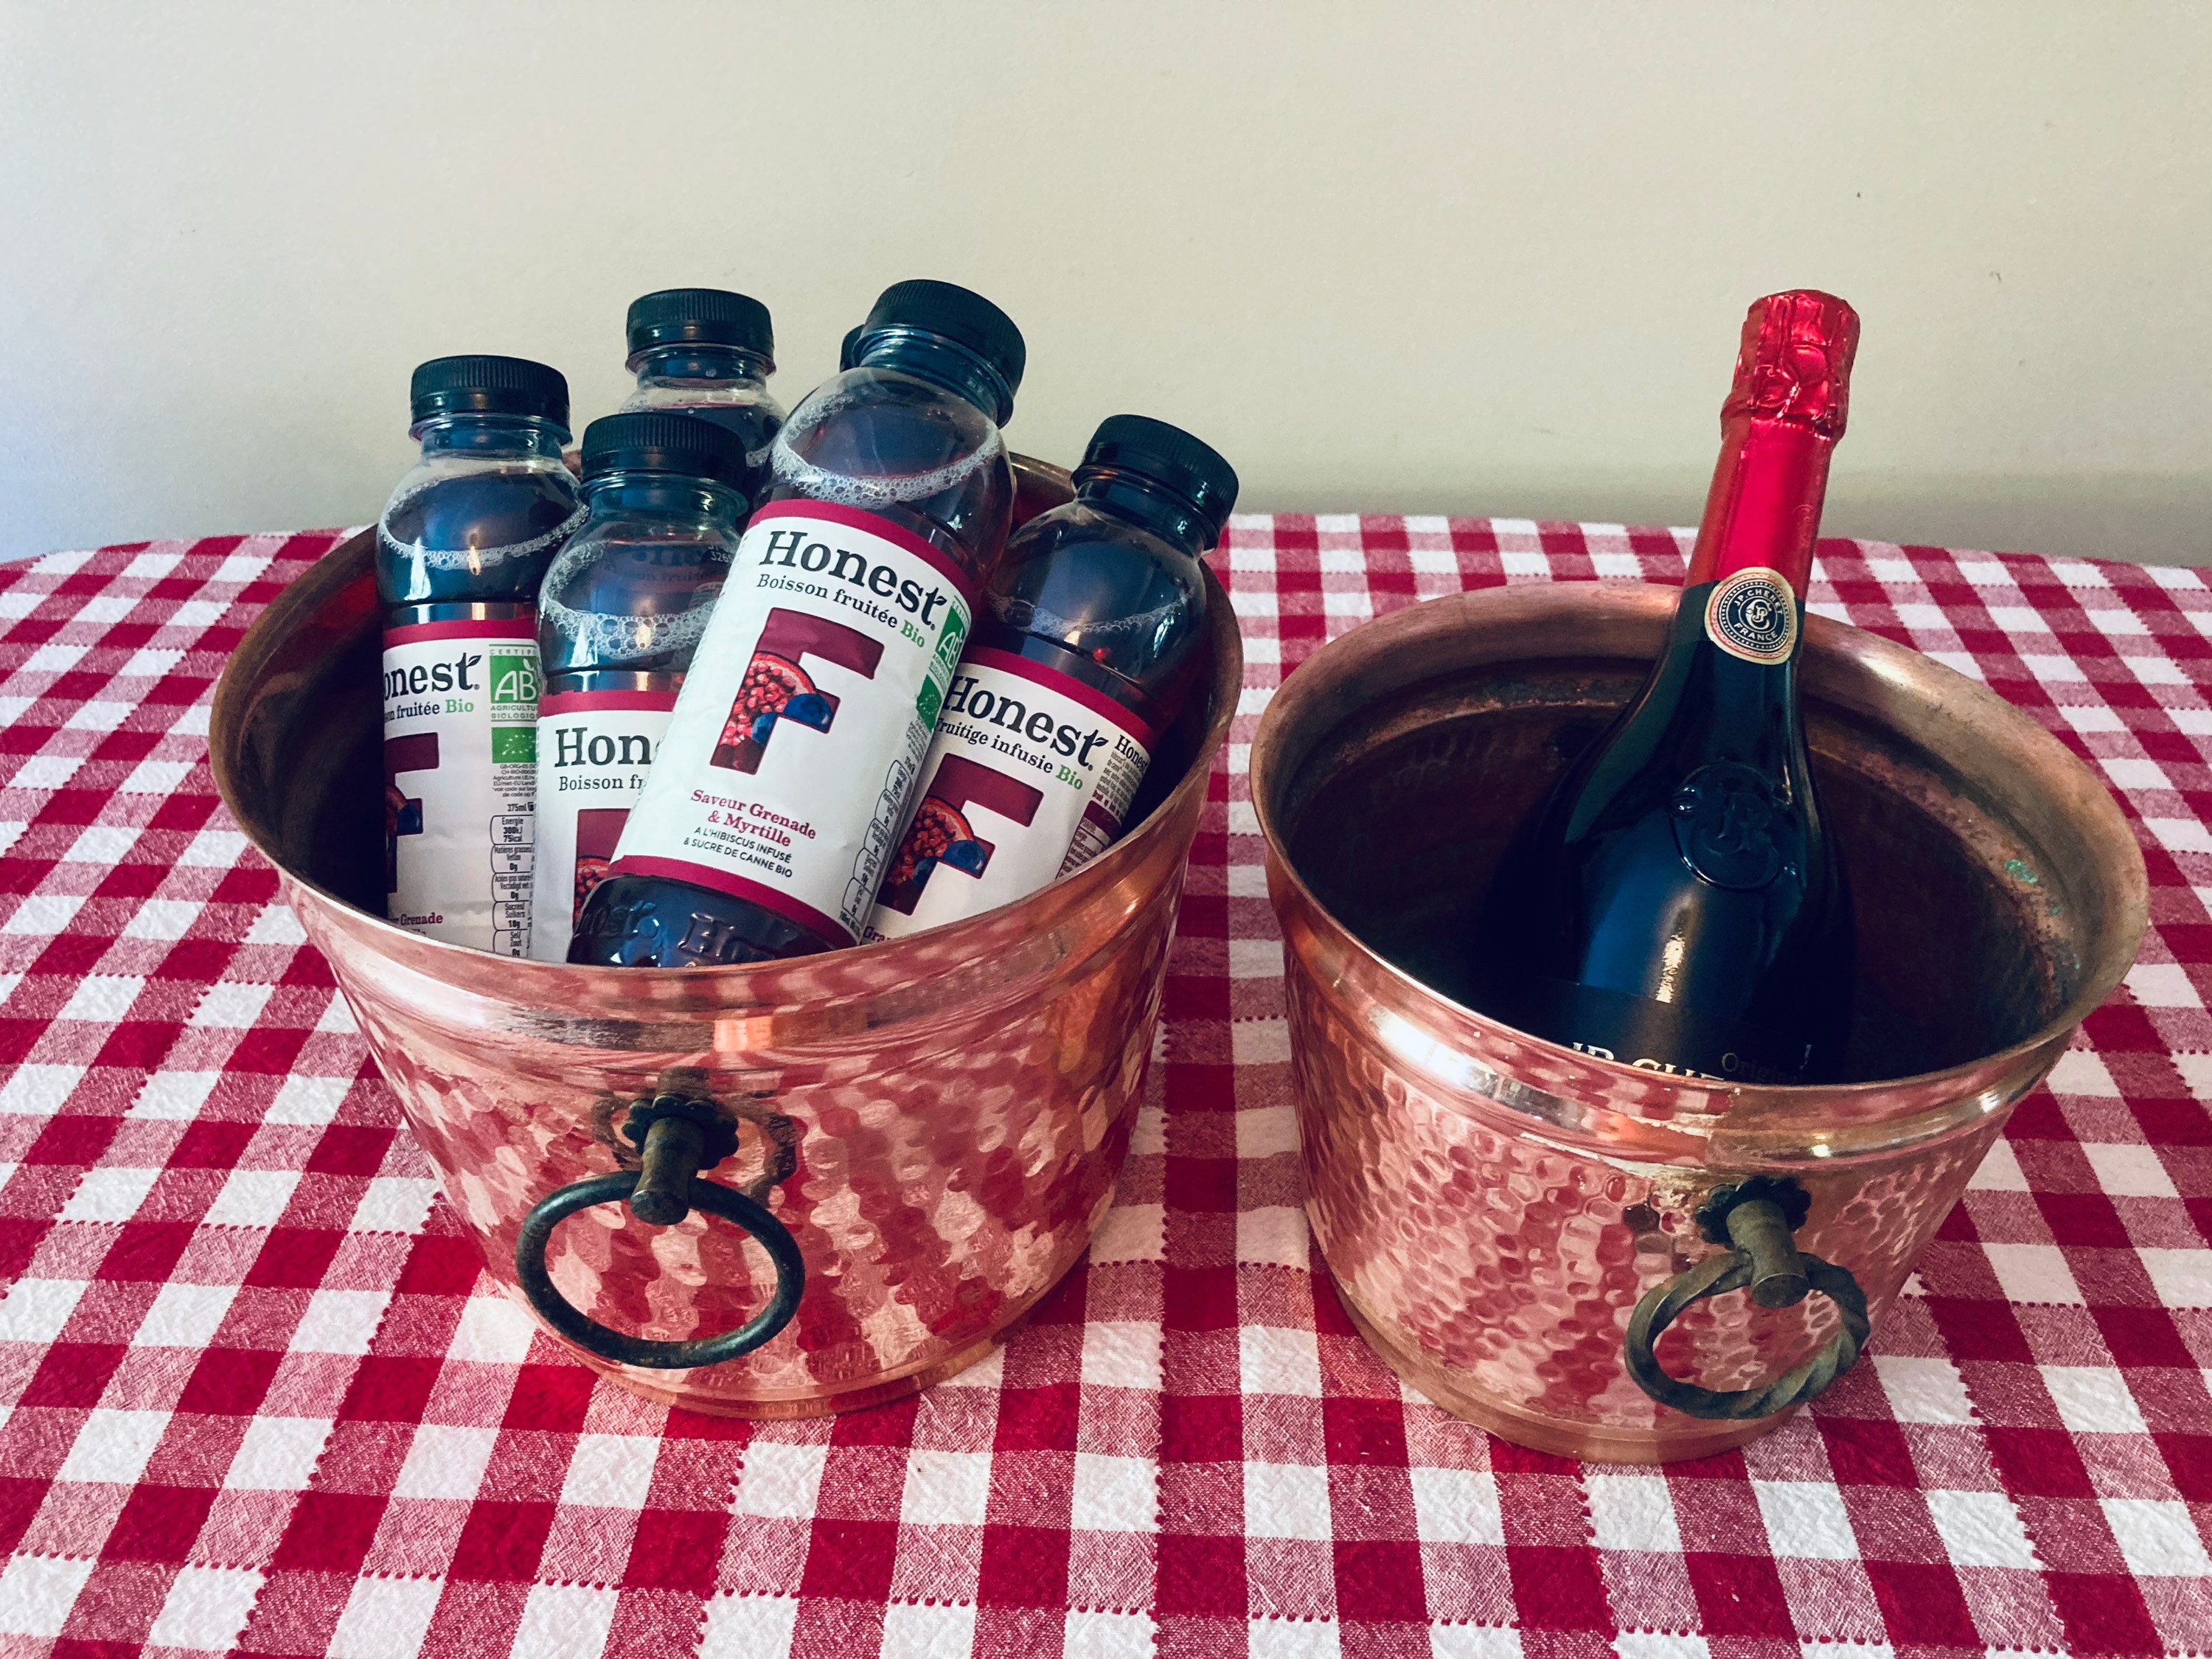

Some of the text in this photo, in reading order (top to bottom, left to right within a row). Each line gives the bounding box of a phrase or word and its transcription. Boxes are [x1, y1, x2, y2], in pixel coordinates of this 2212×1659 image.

[758, 530, 947, 627] Honest
[757, 574, 925, 648] Boisson fruitée Bio
[1733, 622, 1778, 641] FRANCE
[495, 669, 537, 700] AB
[397, 701, 440, 719] fruitée
[445, 699, 474, 714] Bio
[942, 675, 1108, 768] Honest
[554, 726, 660, 767] Hon
[991, 735, 1054, 773] infusie
[1055, 764, 1082, 790] Bio
[559, 776, 624, 791] Boisson
[501, 817, 524, 826] Energie
[690, 788, 816, 840] Saveur Grenade
[708, 810, 791, 847] & Myrtille
[683, 837, 793, 878] & SUCRE DE CANNE BIO
[702, 827, 755, 851] L'HIBISCUS
[755, 843, 793, 863] INFUSÉ
[400, 912, 443, 925] Grenade
